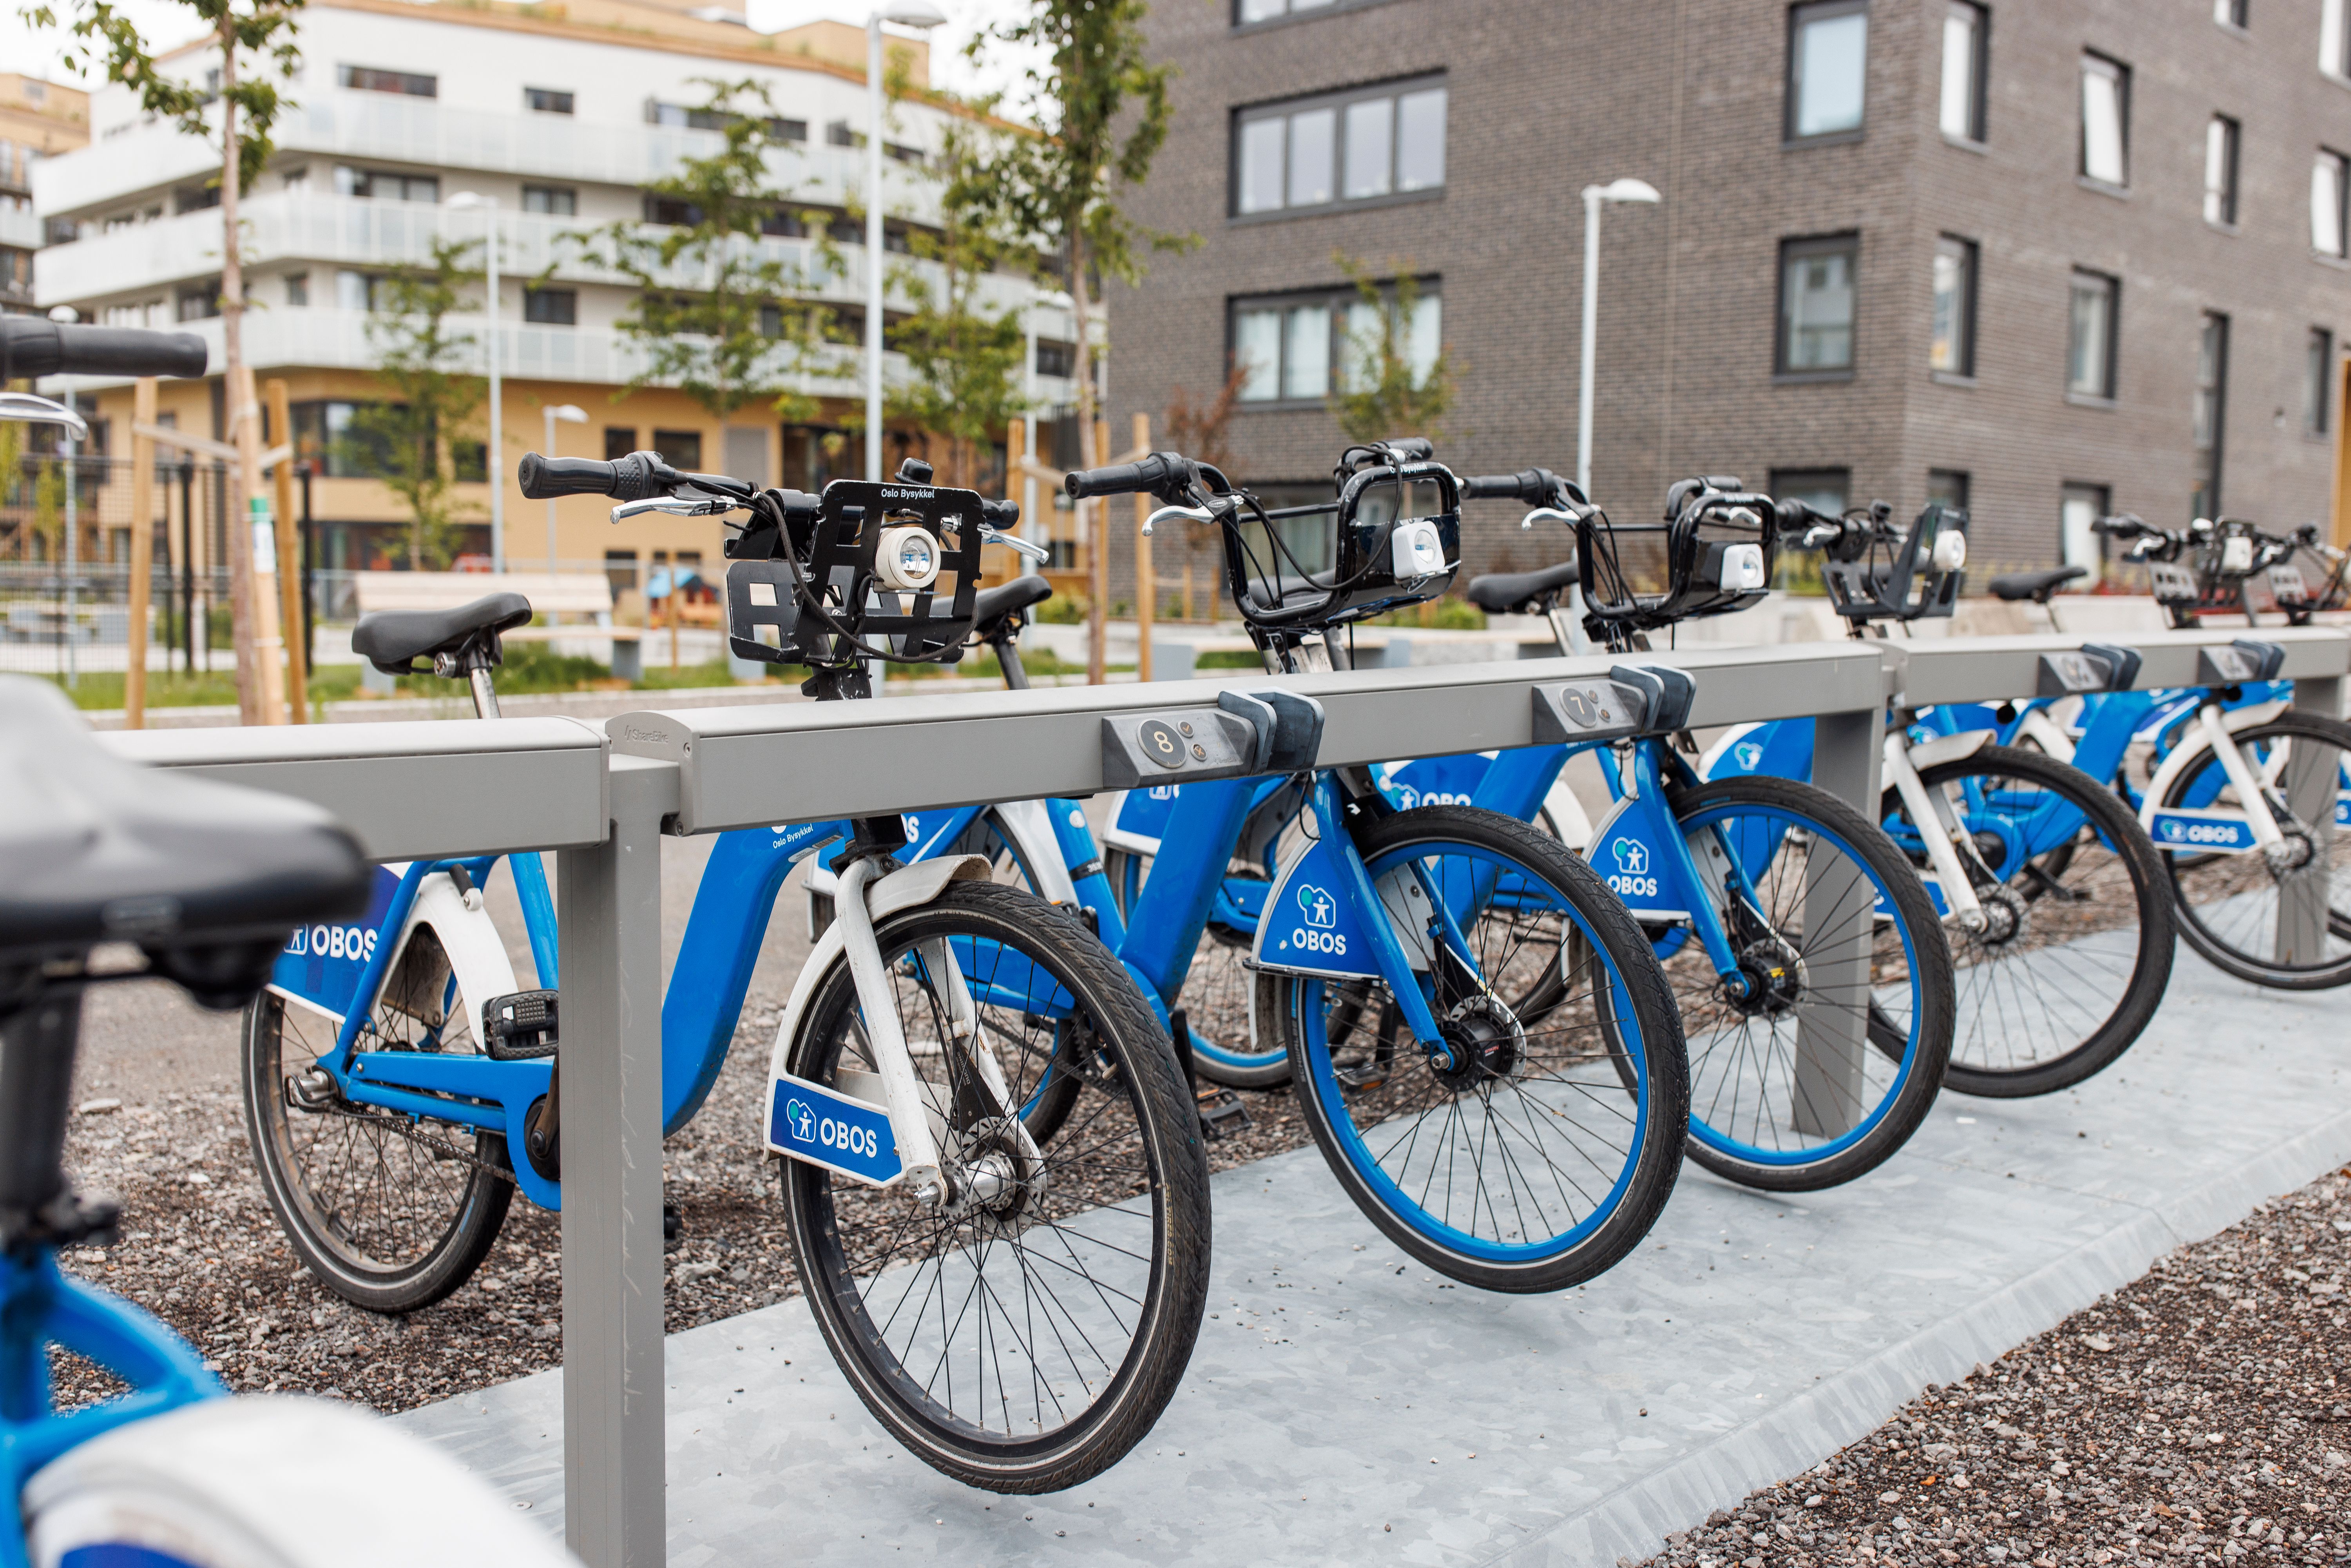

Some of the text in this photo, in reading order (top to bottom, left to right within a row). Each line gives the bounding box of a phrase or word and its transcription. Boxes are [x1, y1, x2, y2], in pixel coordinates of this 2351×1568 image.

[881, 488, 935, 500] Oslo Bysykkel
[1570, 696, 1585, 715] 7
[632, 729, 669, 743] ShareBike
[1153, 730, 1174, 753] 8
[773, 823, 813, 849] Oslo Bysykkel
[2188, 824, 2239, 844] OBOS
[1608, 875, 1658, 897] OBOS
[311, 924, 379, 963] OBOS
[1292, 927, 1346, 956] OBOS
[820, 1117, 878, 1158] OBOS
